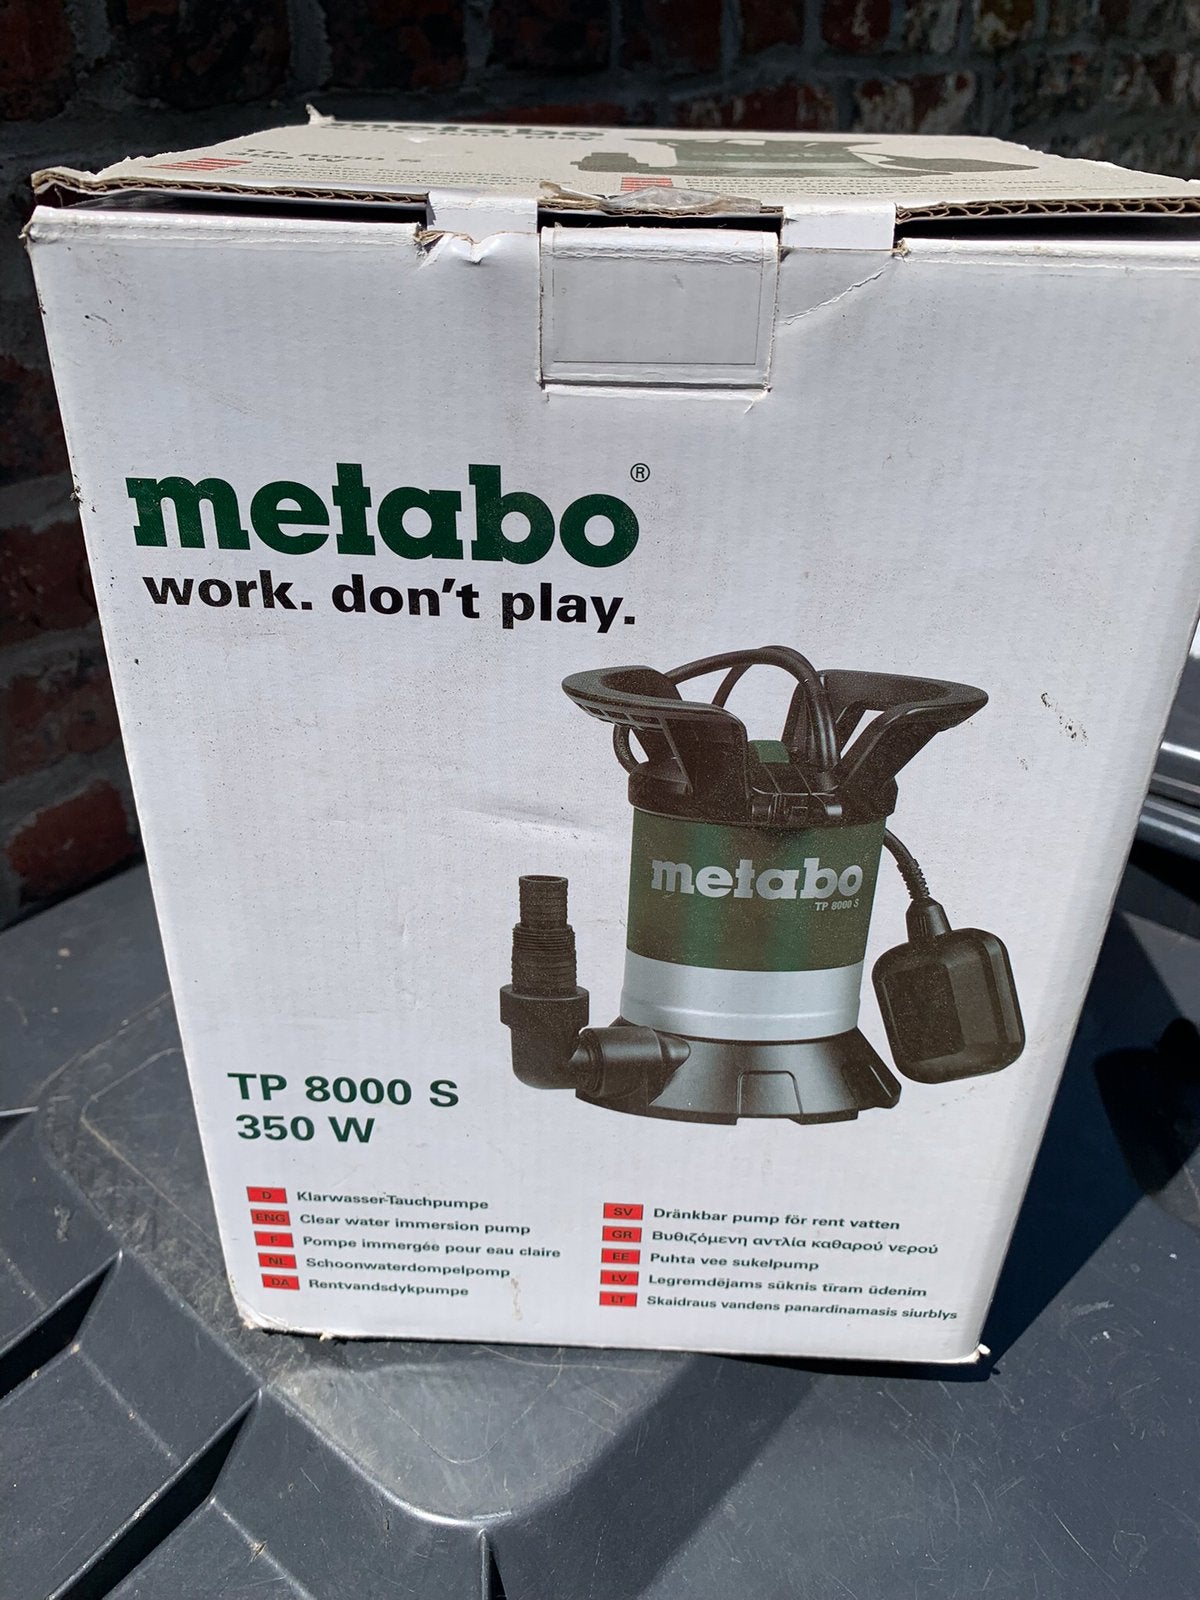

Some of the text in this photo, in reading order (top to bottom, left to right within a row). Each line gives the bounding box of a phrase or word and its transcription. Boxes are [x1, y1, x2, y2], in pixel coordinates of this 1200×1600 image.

[125, 463, 640, 569] metabo
[142, 570, 636, 634] work. don't play.
[651, 857, 863, 900] metabo
[815, 899, 859, 911] TP 8000 S
[227, 1072, 459, 1108] TP 8000 S
[236, 1114, 375, 1143] 350 W
[261, 1191, 272, 1200] D
[297, 1191, 488, 1210] Klarwasser-Tauchpumpe
[255, 1213, 286, 1223] ENG
[613, 1207, 634, 1216] SV
[653, 1208, 900, 1230] Dränkbar pump för rent vatten
[300, 1214, 531, 1236] Clear water immersion pump
[270, 1235, 278, 1244] F
[611, 1230, 632, 1239] GR
[303, 1236, 561, 1258] Pompe immergée pour eau claire
[752, 1237, 806, 1248] αντλία
[811, 1239, 883, 1253] καθαρού
[888, 1244, 938, 1255] νερού
[268, 1257, 287, 1266] NL
[612, 1252, 630, 1261] EE
[650, 1252, 819, 1272] Puhta vee sukelpump
[306, 1258, 510, 1278] Schoonwaterdompelpomp
[271, 1278, 290, 1287] DA
[611, 1273, 628, 1282] LV
[308, 1279, 469, 1297] Rentvandsdykpumpe
[611, 1295, 626, 1303] LT
[647, 1295, 957, 1321] Skaidraus vandens panardinamasis siurblys
